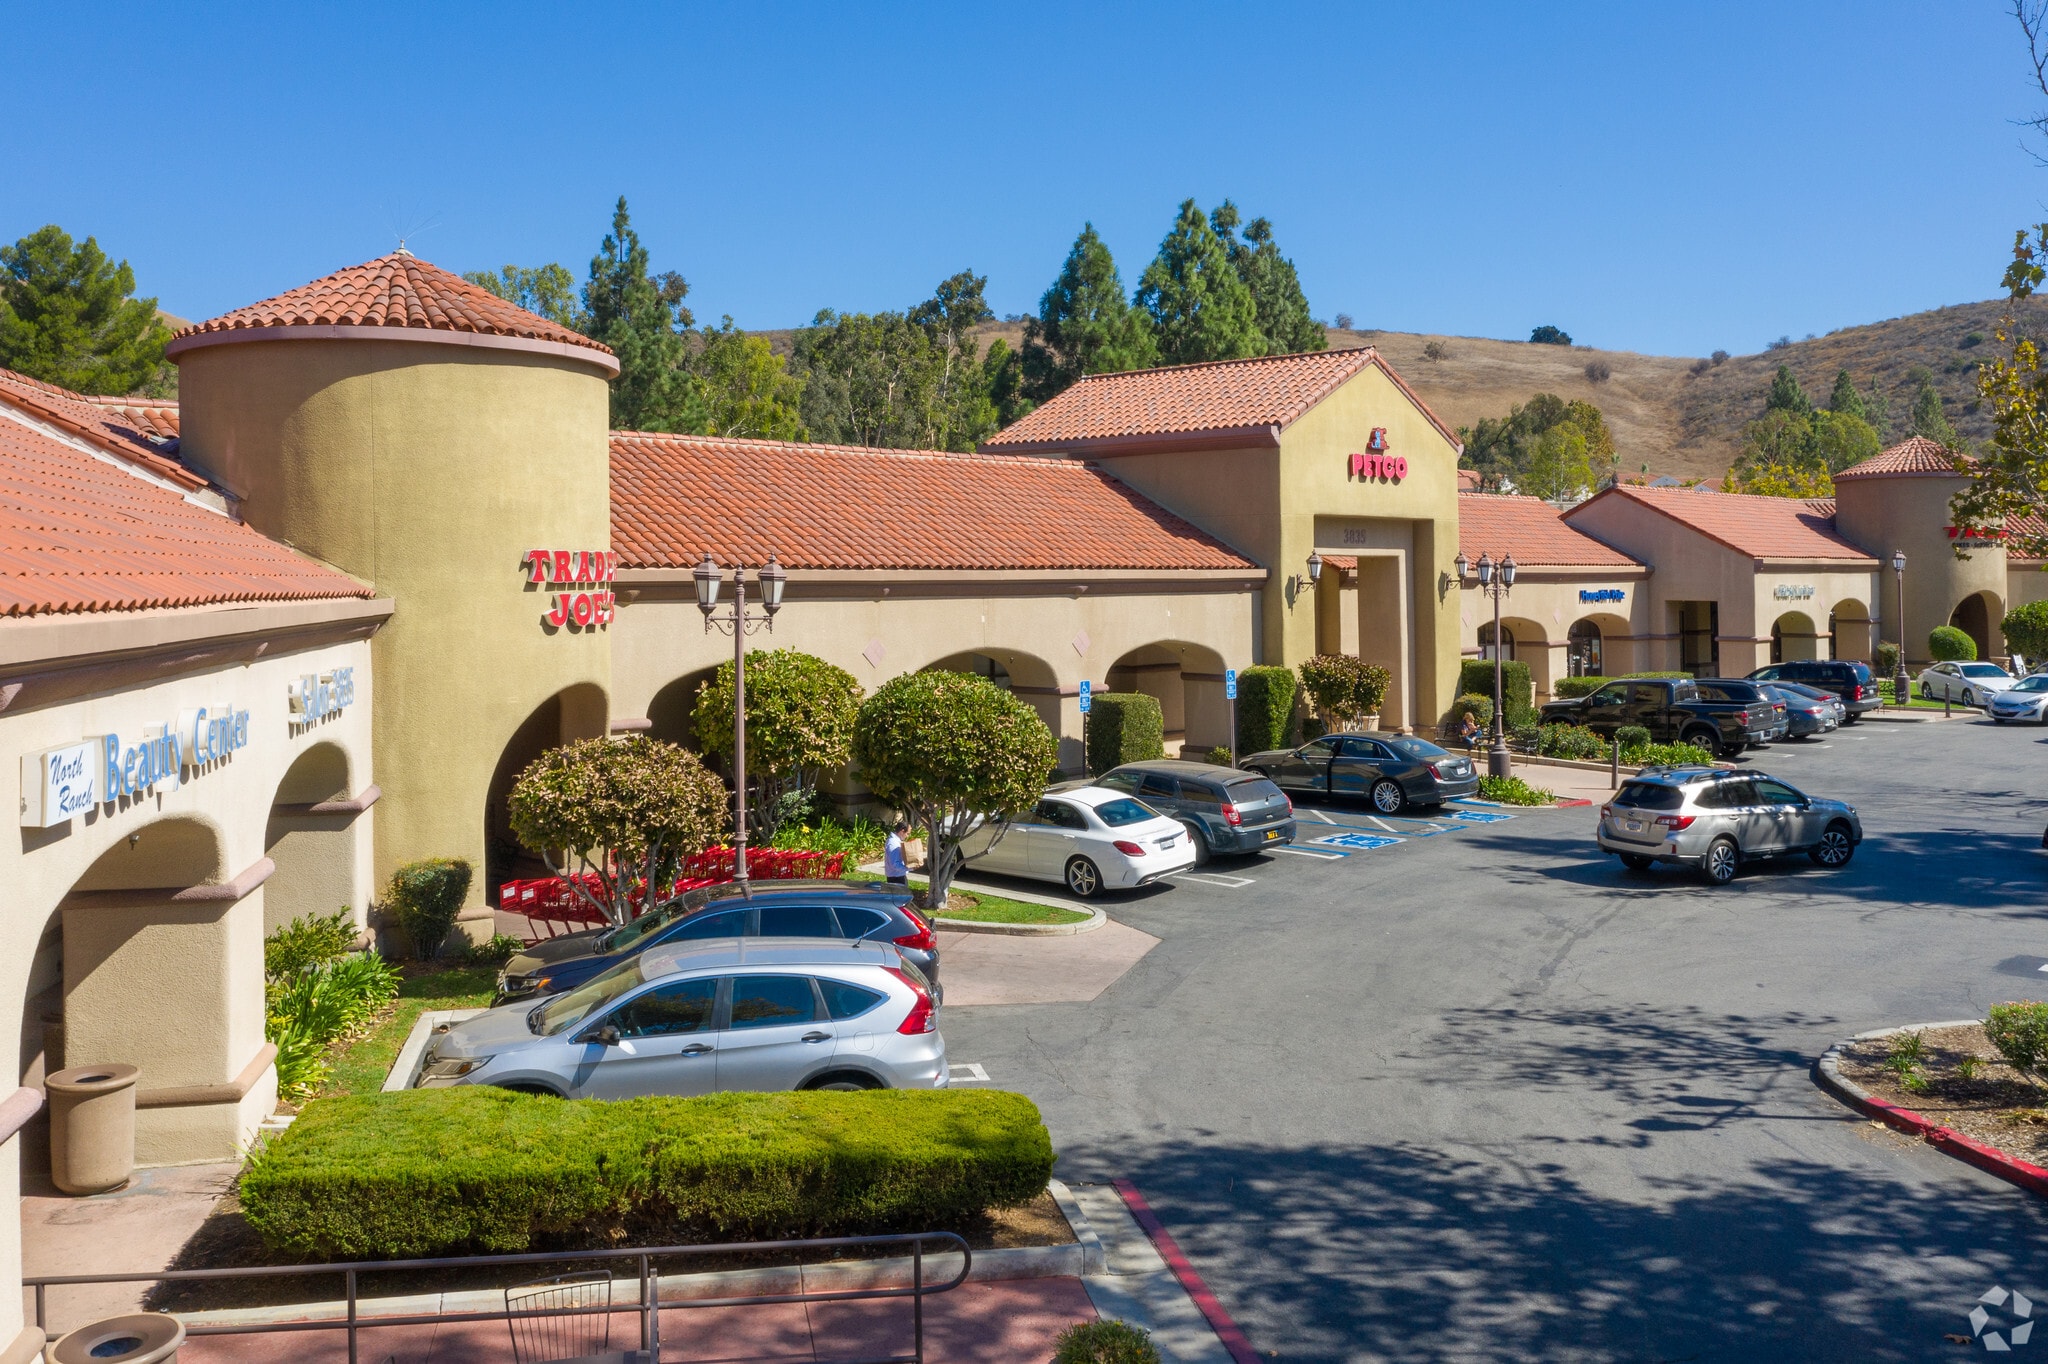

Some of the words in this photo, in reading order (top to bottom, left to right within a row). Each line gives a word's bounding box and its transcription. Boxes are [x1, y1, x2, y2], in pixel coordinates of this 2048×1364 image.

[1351, 453, 1408, 479] PETCO
[50, 749, 84, 785] North
[104, 721, 184, 803] Beauty
[192, 703, 250, 766] Center
[58, 779, 94, 818] Ranch
